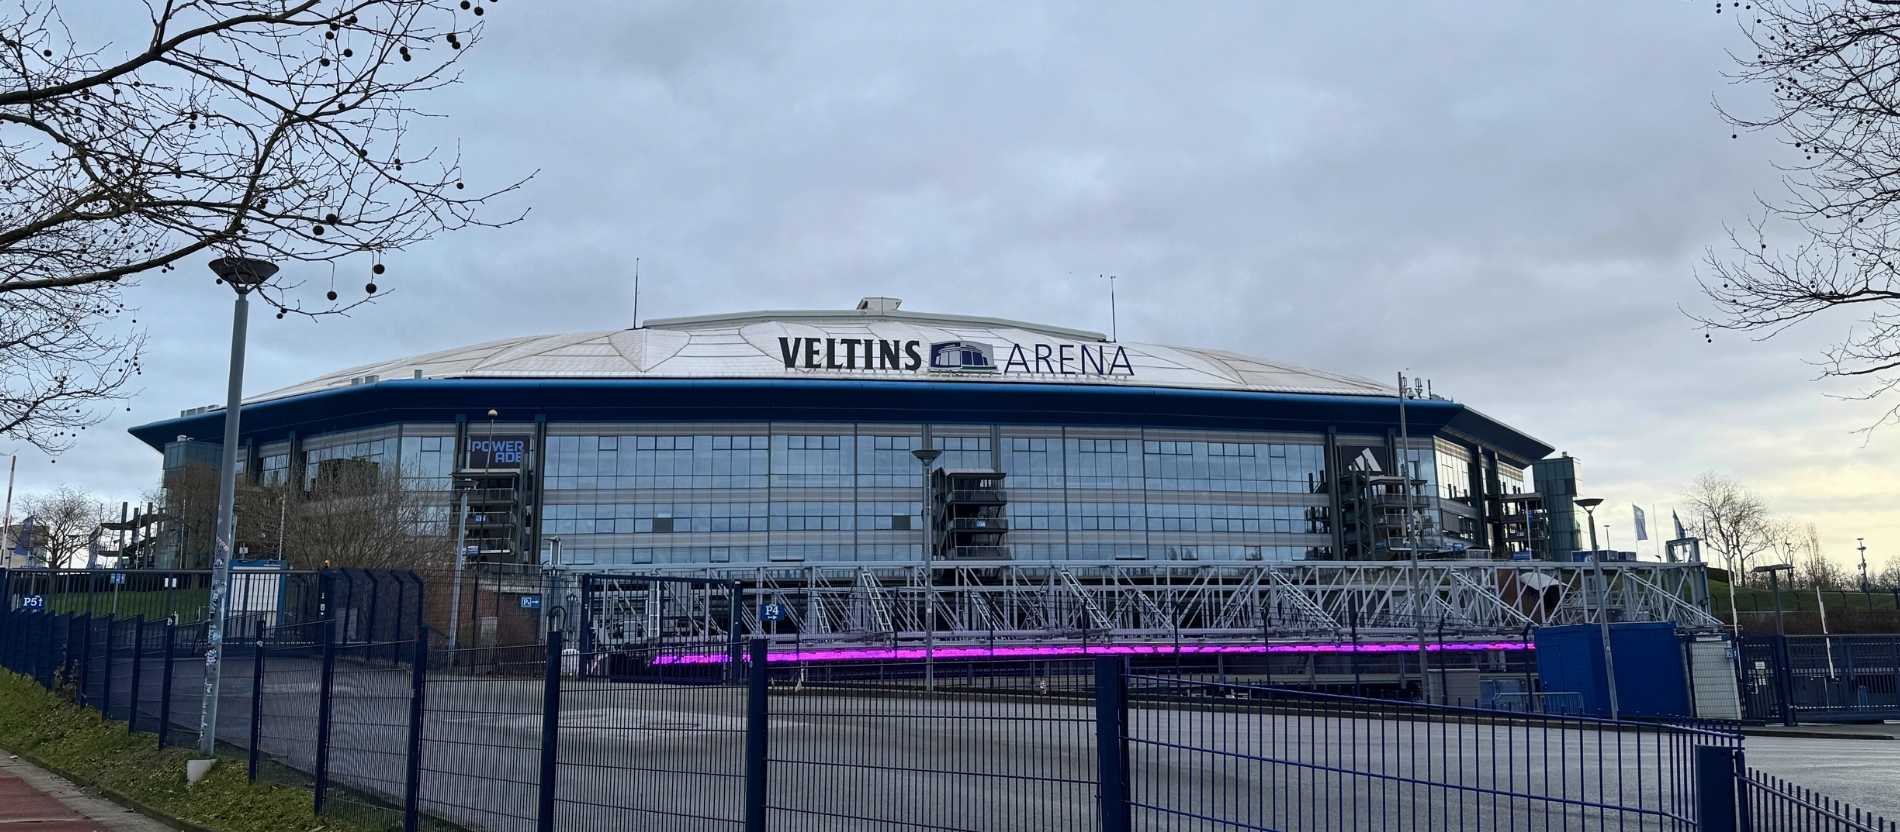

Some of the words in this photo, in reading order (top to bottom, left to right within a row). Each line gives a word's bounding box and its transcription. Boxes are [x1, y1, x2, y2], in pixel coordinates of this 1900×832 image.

[778, 337, 922, 371] VELTINS
[1004, 343, 1135, 376] ARENA
[472, 440, 525, 452] POWER
[765, 605, 779, 616] P4
